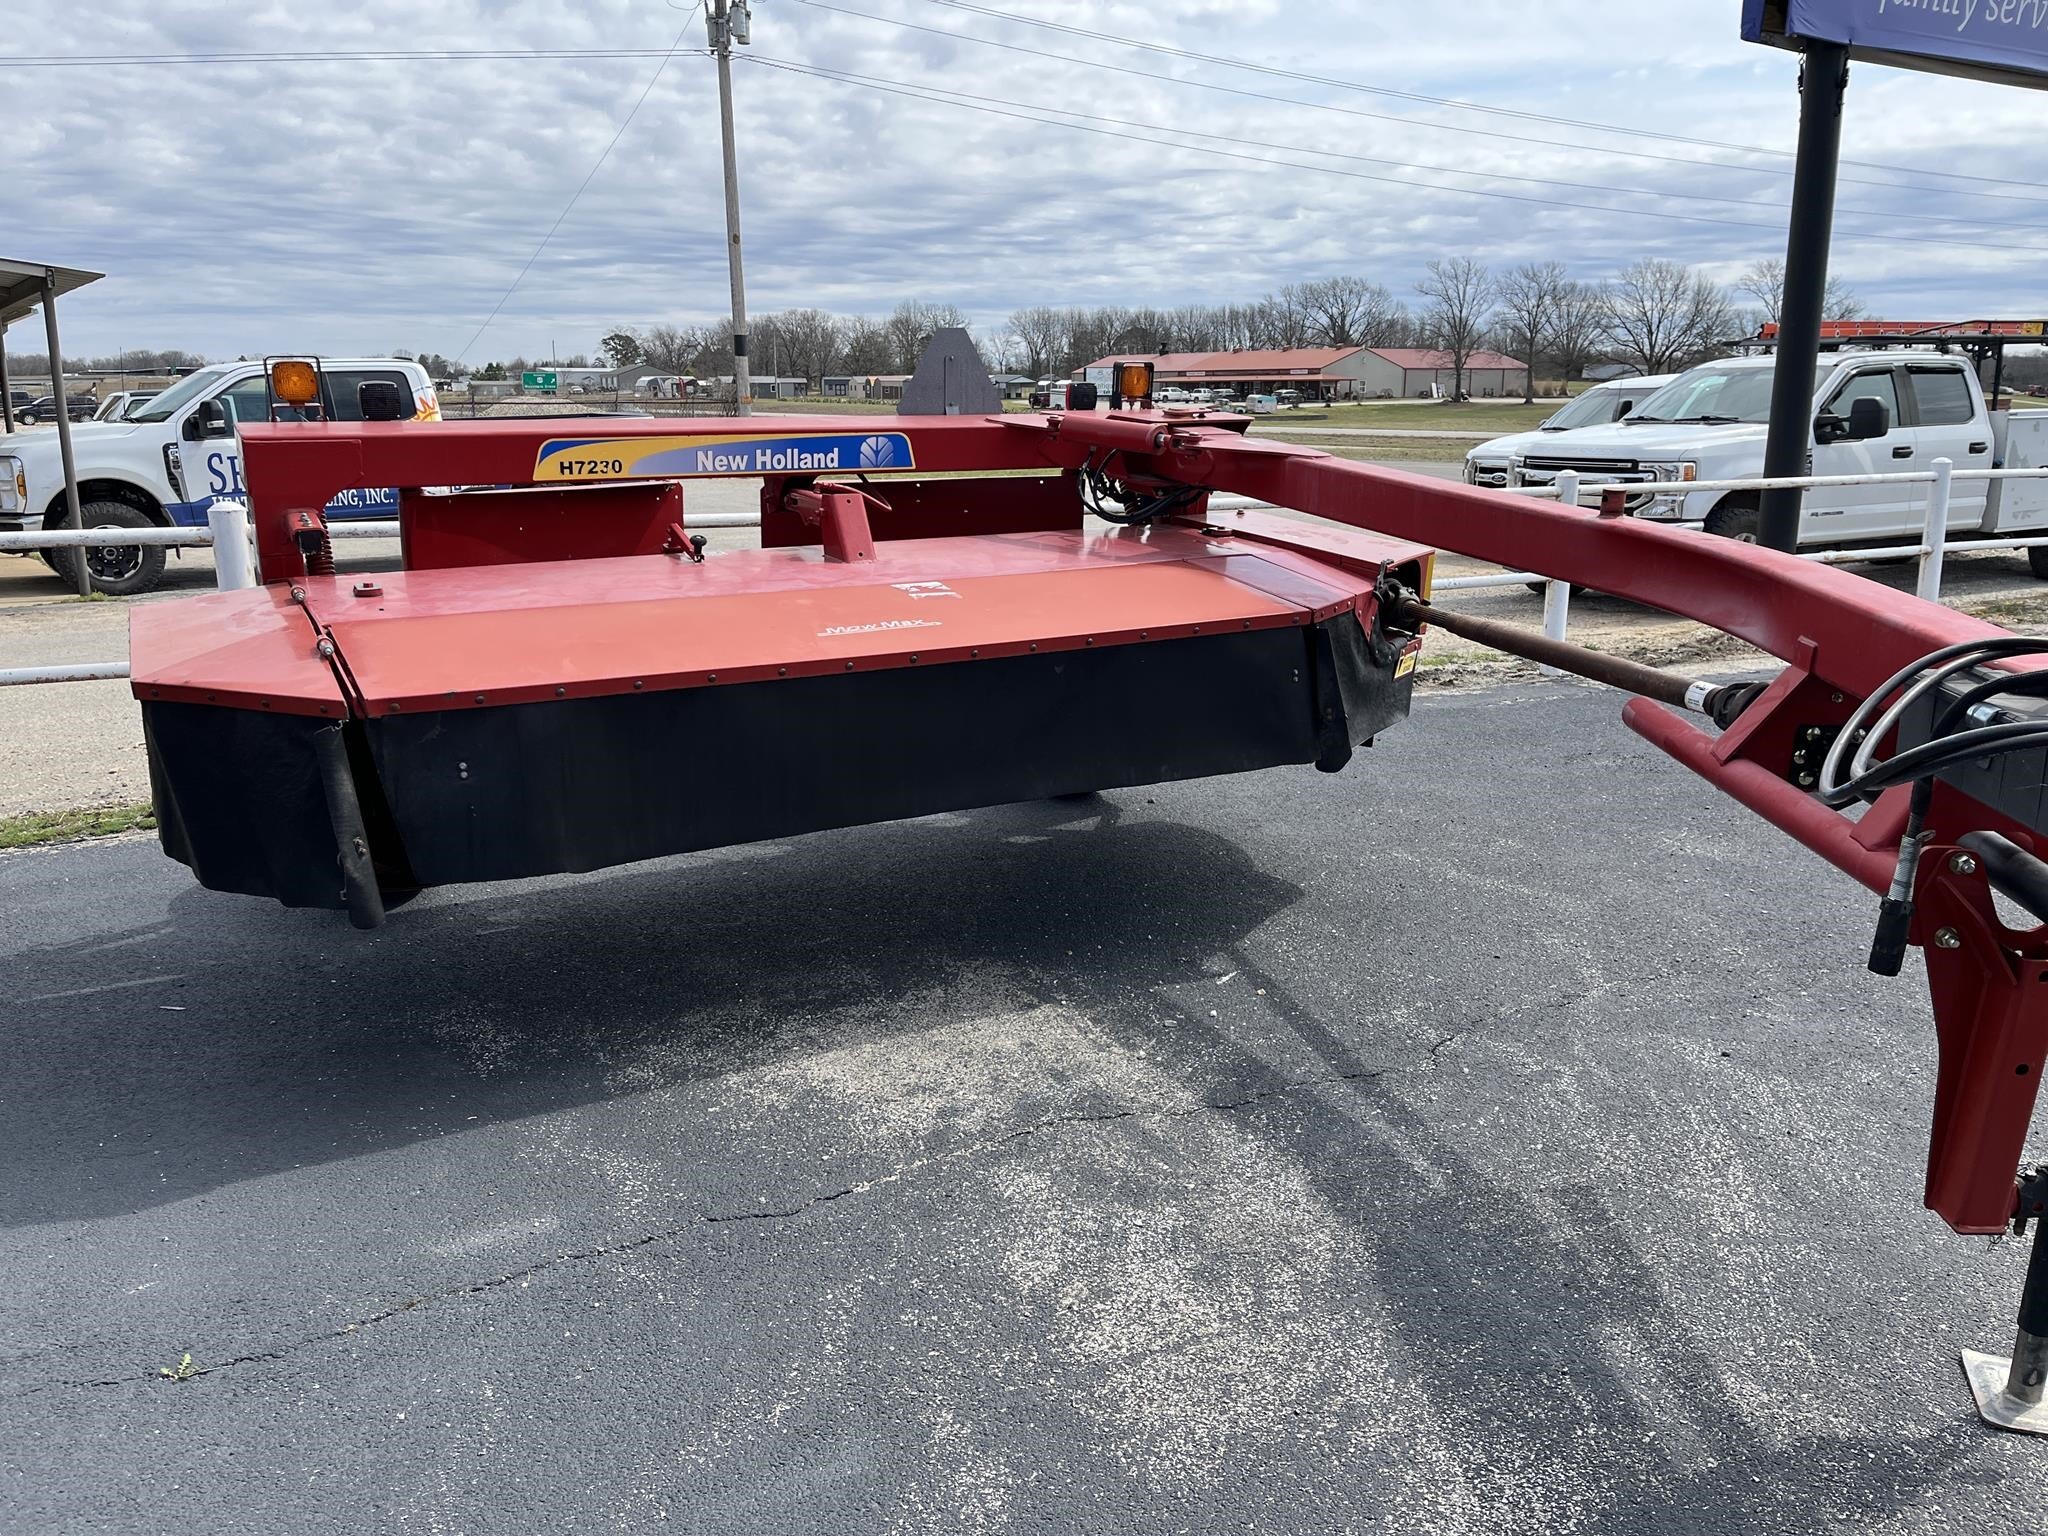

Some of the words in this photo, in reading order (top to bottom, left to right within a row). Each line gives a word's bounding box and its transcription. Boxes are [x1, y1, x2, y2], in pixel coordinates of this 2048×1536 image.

[1985, 0, 2048, 29] serv
[559, 459, 622, 475] H7230
[696, 450, 748, 472] New
[755, 447, 839, 470] Holland
[364, 487, 394, 504] INC.
